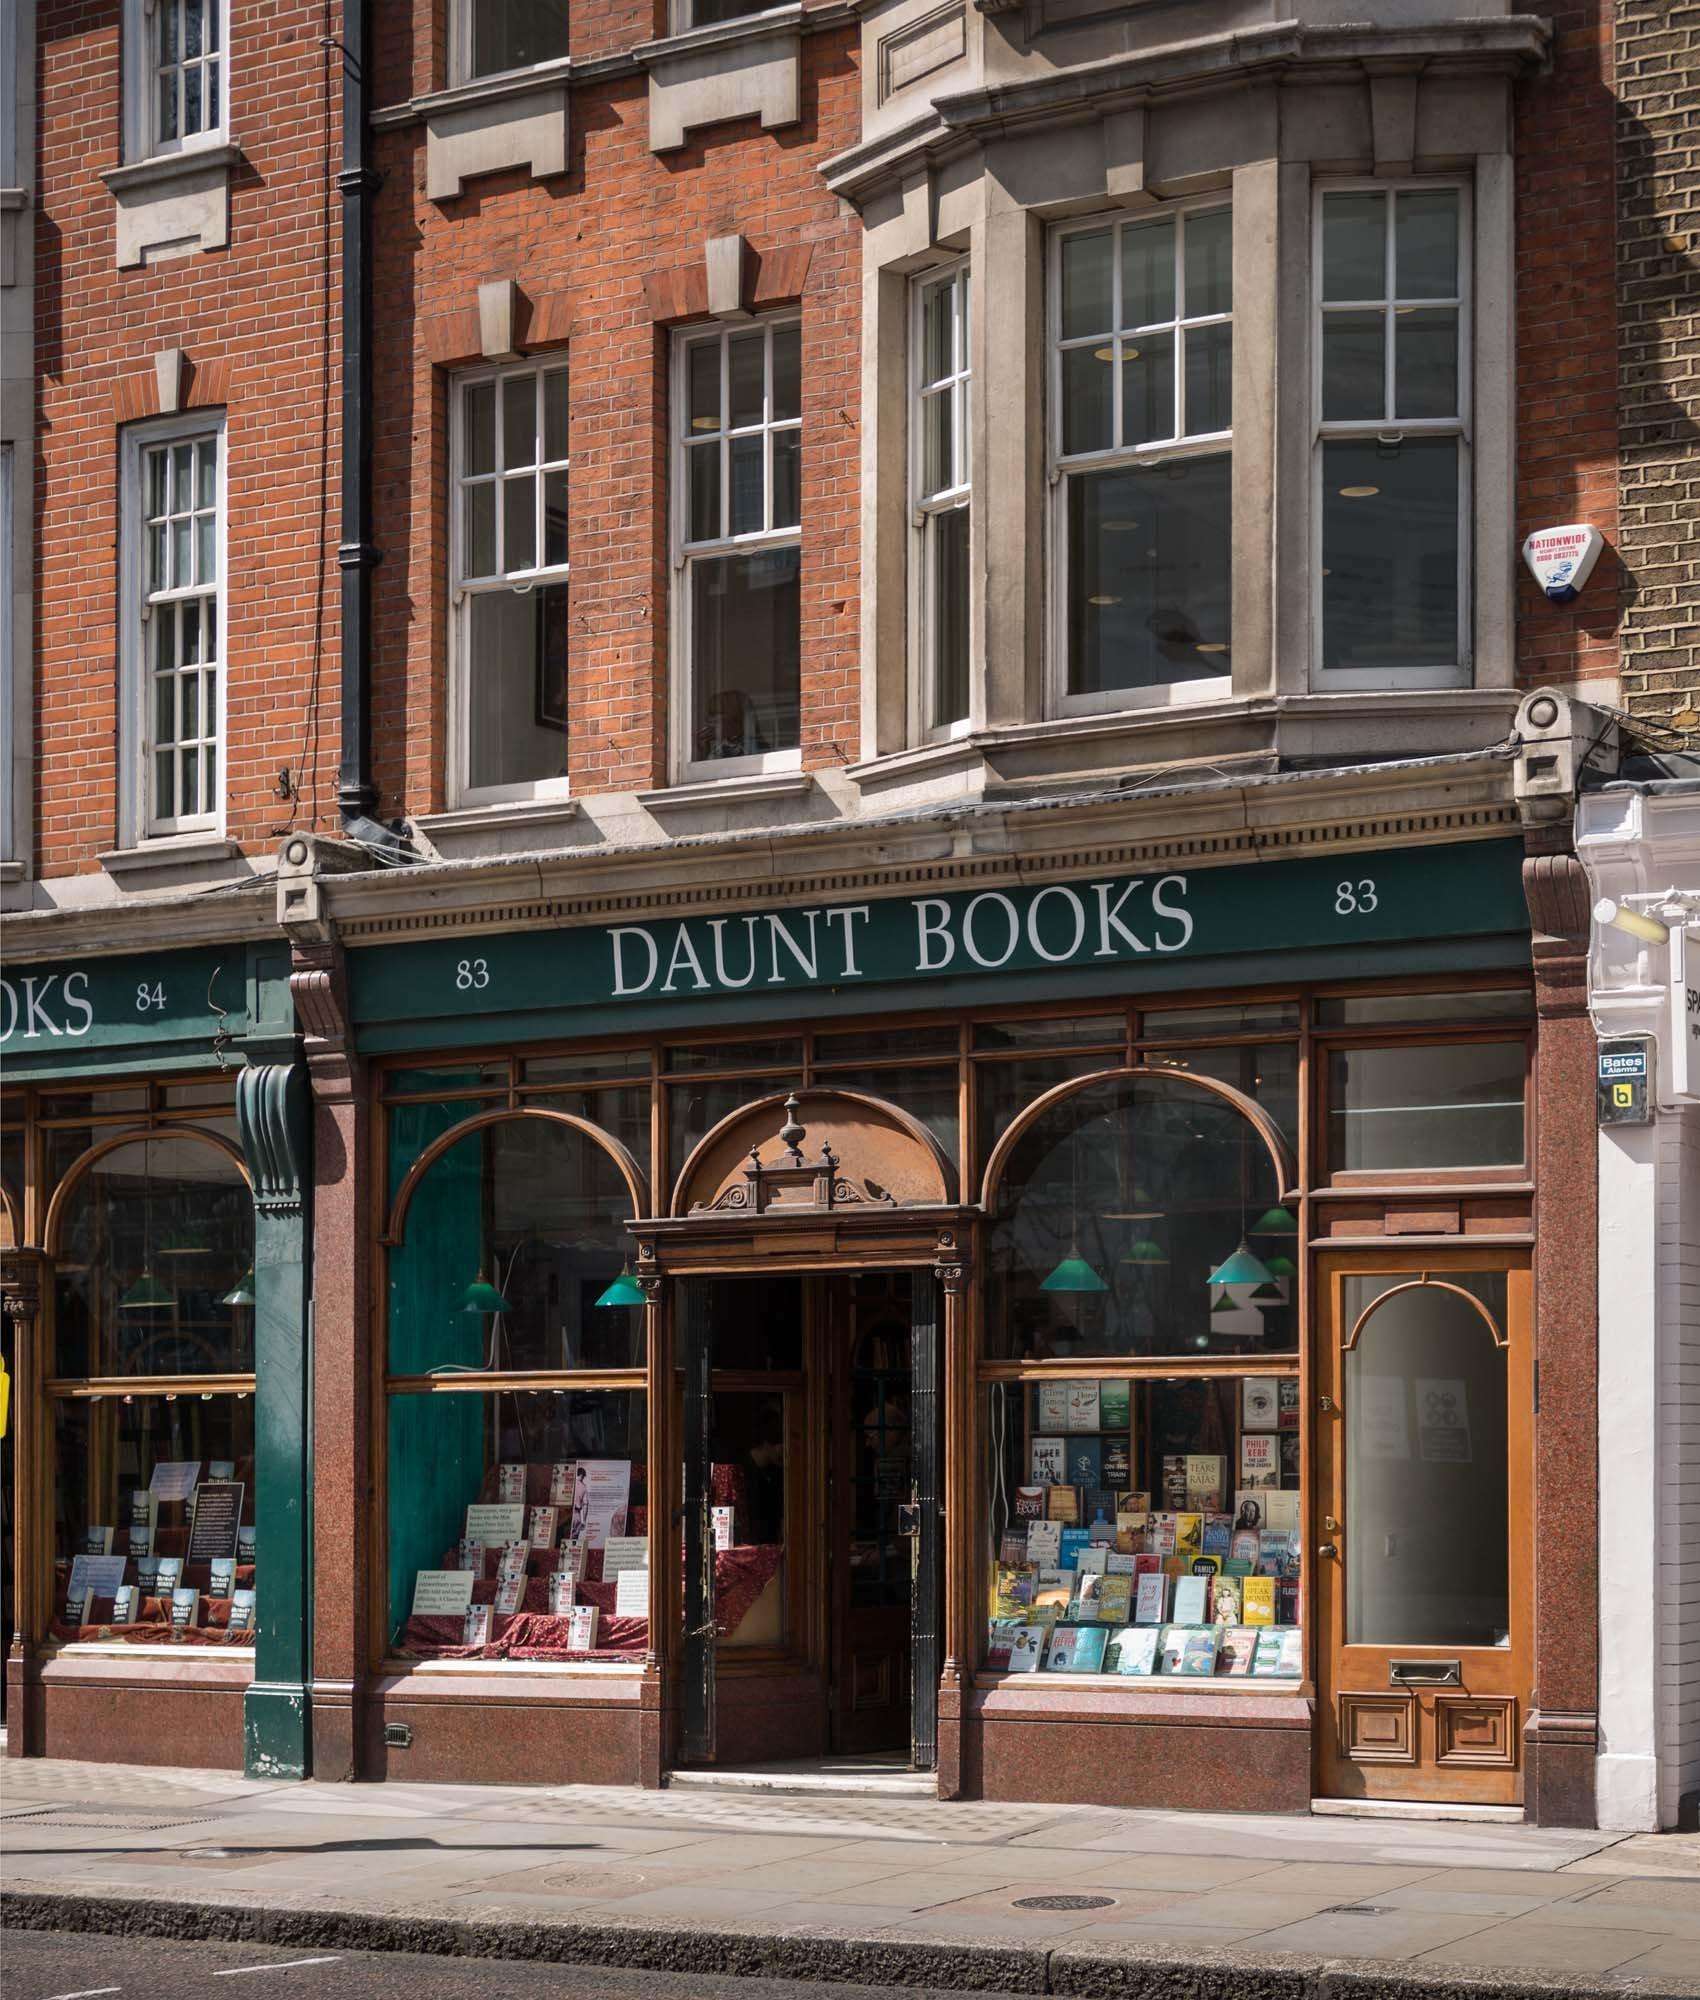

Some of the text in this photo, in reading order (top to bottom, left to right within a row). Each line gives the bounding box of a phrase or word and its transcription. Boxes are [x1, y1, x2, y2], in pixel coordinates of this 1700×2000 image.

[1529, 534, 1586, 550] NATIONWIDE
[1335, 879, 1378, 915] 83
[606, 875, 1195, 996] DAUNT BOOKS
[456, 959, 489, 989] 83
[136, 981, 167, 1011] 84
[1603, 1058, 1642, 1068] Bates
[1608, 1066, 1638, 1075] Alarms
[1246, 1440, 1270, 1448] PHILIP
[1247, 1449, 1268, 1457] KERR
[1190, 1463, 1216, 1472] TEARS
[1190, 1474, 1216, 1485] RAJAS
[1194, 1565, 1216, 1574] FAMILY
